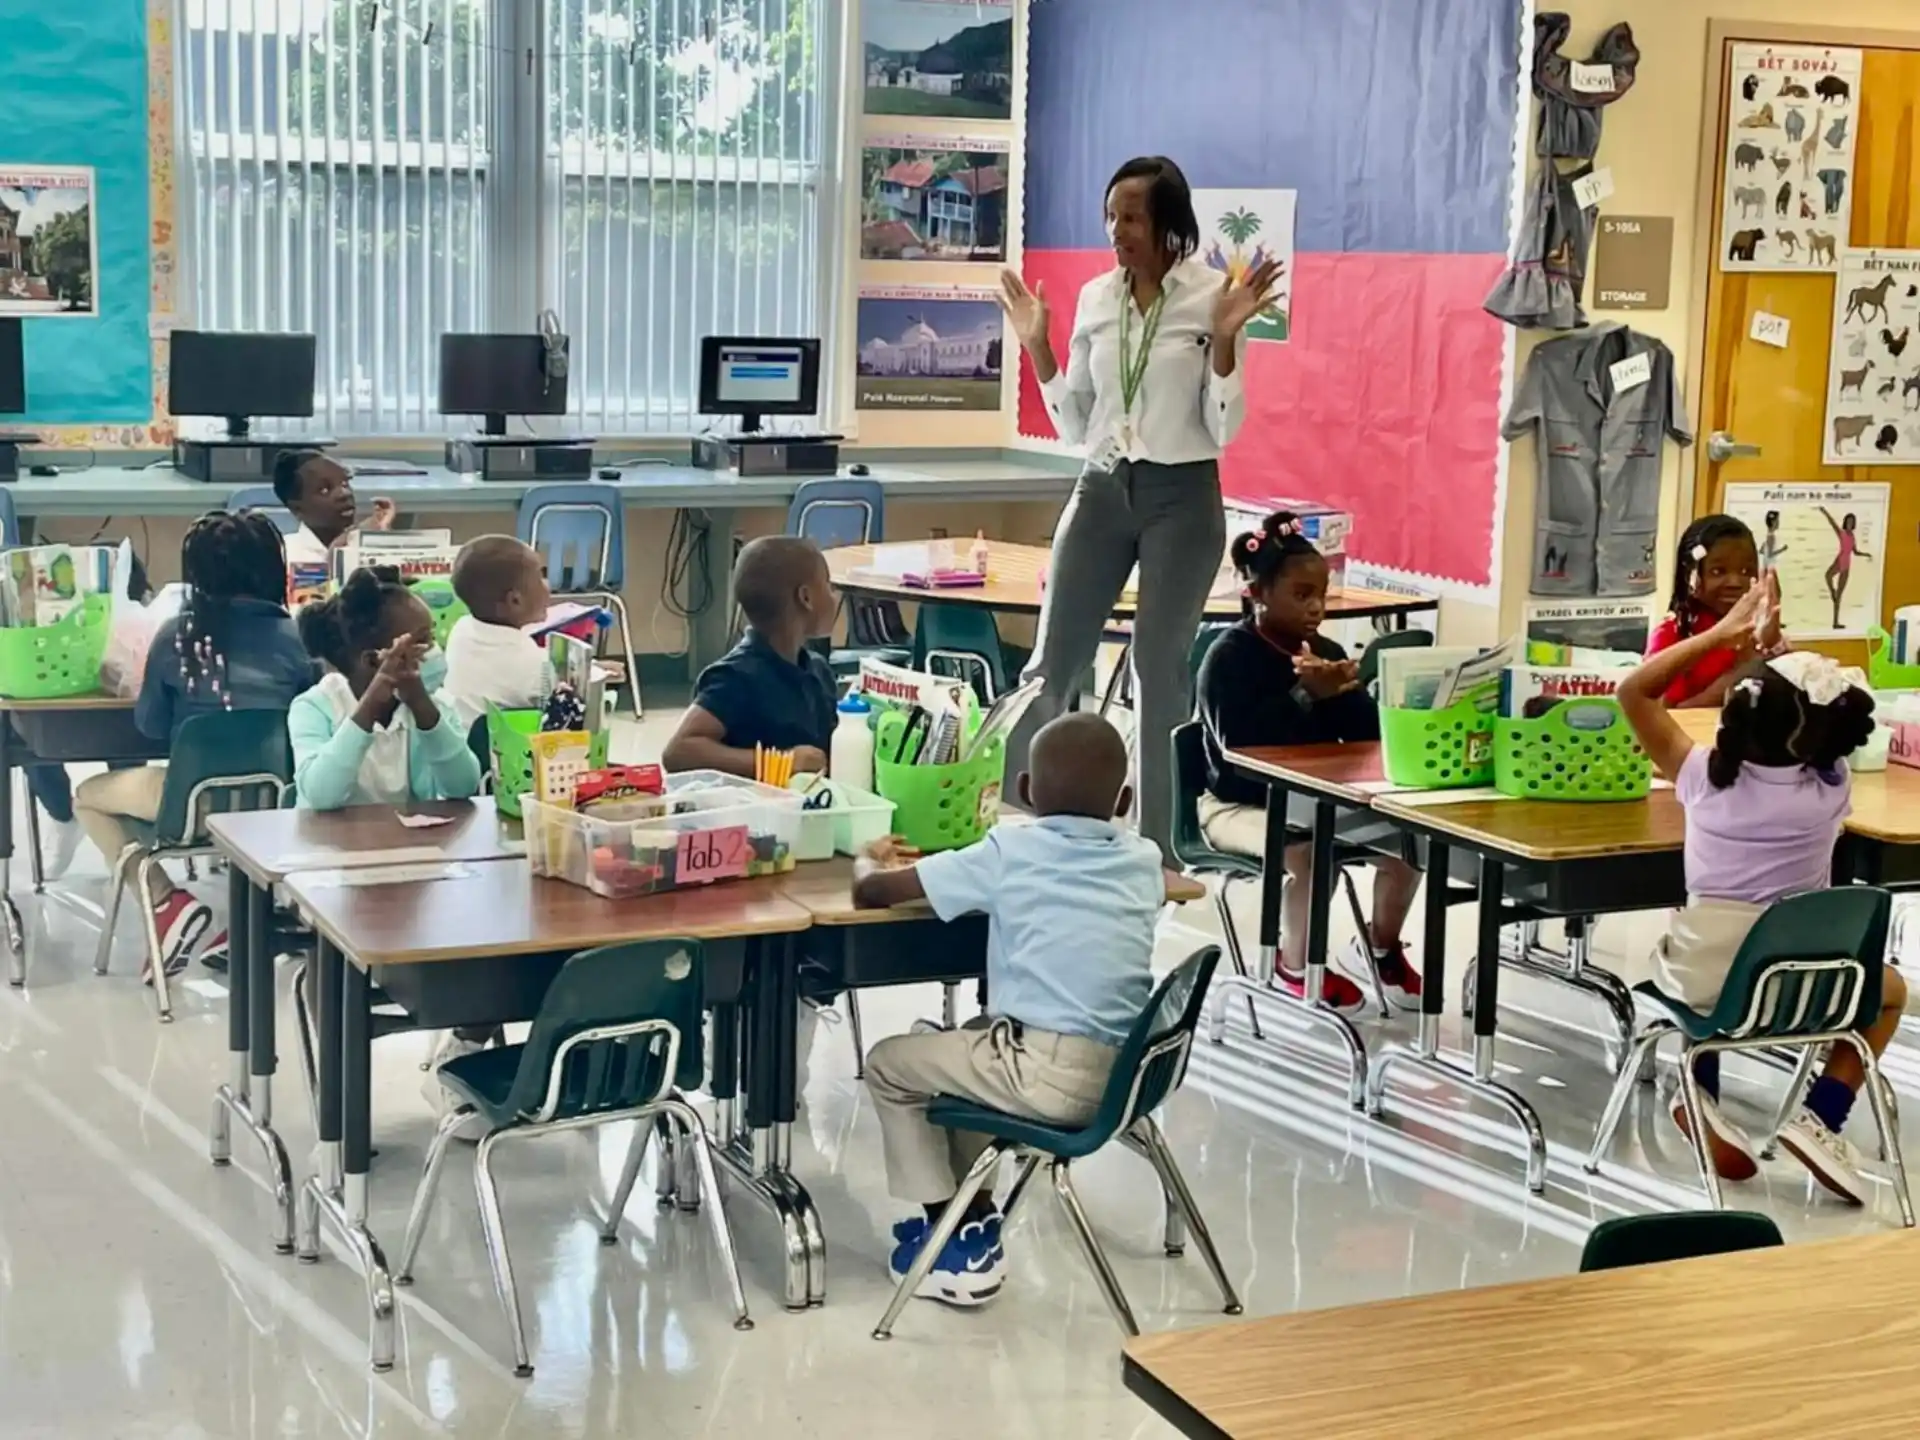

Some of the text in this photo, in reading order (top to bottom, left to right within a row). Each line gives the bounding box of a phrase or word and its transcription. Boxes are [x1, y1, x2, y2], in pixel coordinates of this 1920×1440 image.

[1792, 59, 1838, 72] SOVAJ
[1604, 221, 1641, 234] S-105A
[1887, 260, 1909, 270] NAN
[1600, 290, 1648, 302] STORAGE
[401, 562, 451, 576] MATEM
[1541, 680, 1618, 696] MATEMA
[1888, 723, 1912, 757] ab
[681, 830, 744, 872] tab 2
